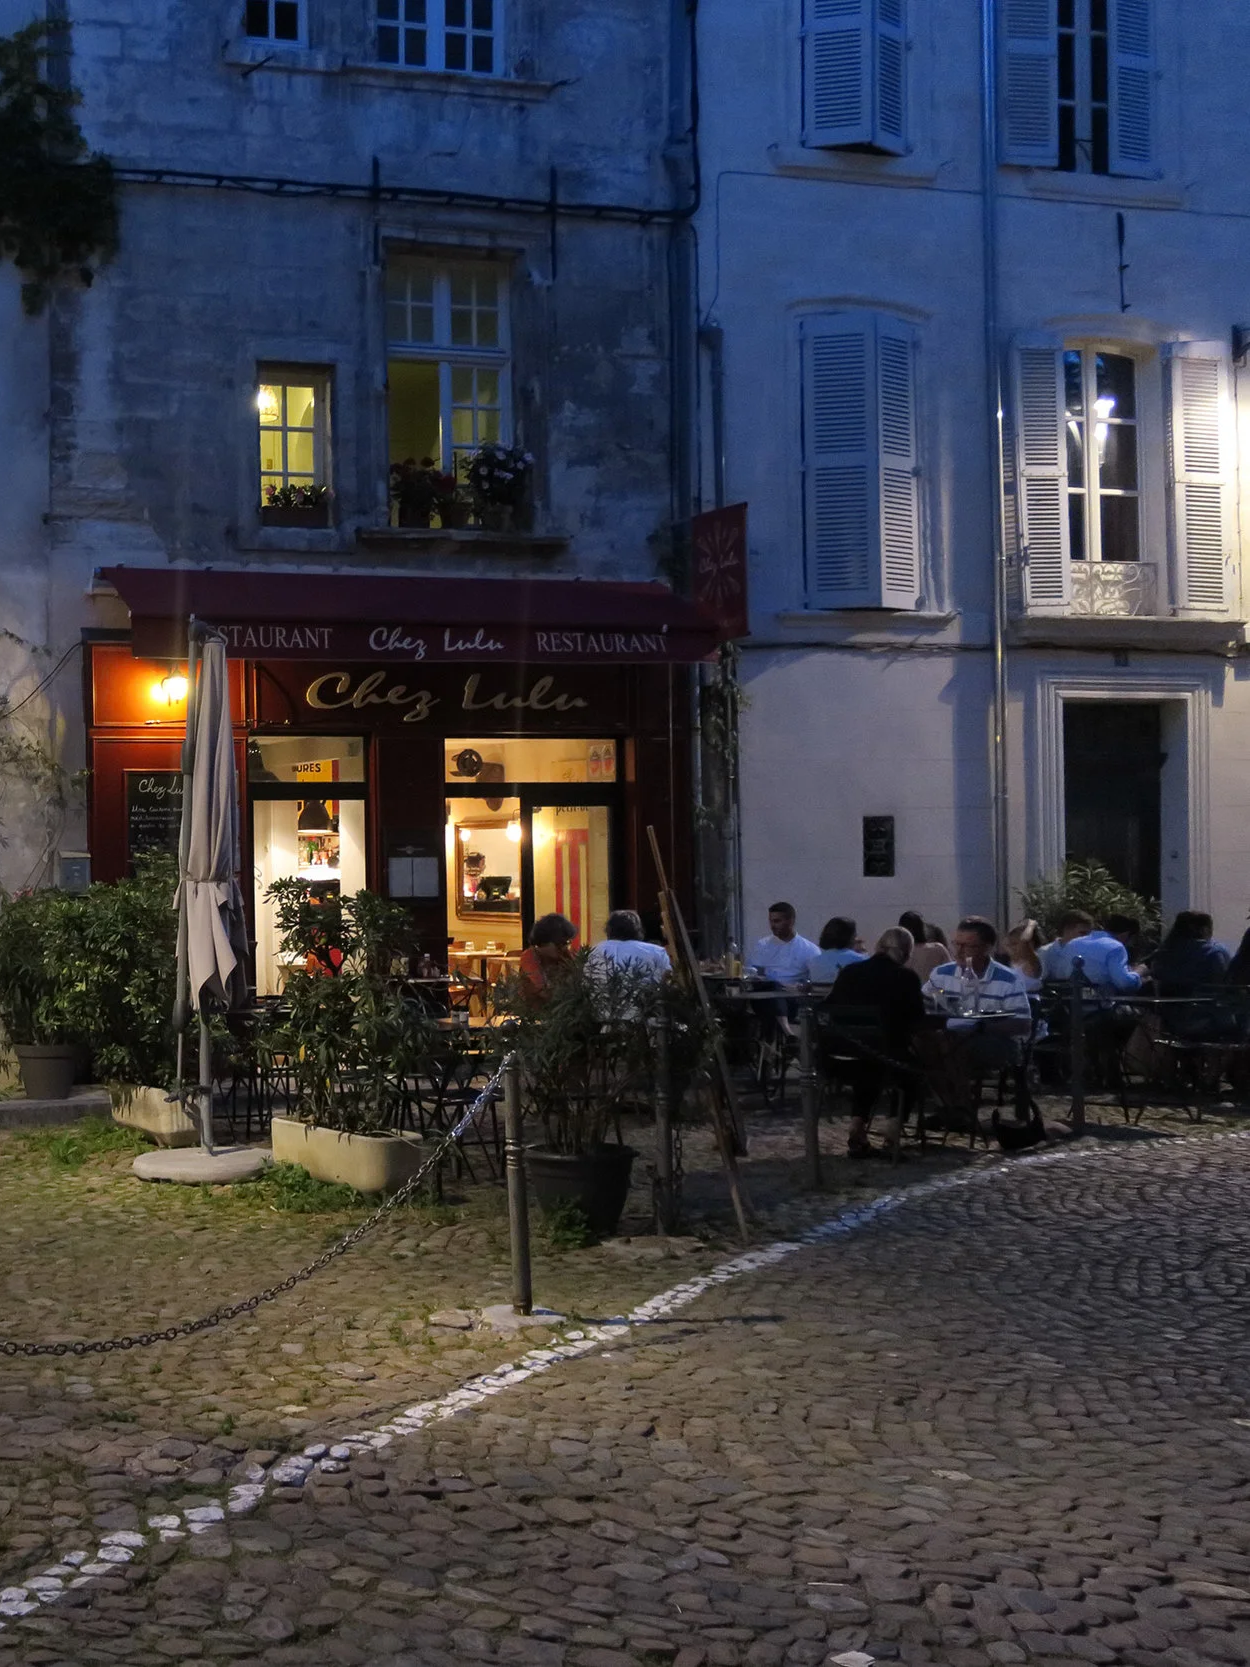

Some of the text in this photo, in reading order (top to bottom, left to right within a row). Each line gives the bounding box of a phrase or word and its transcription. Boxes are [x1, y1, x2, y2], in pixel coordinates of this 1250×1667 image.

[200, 625, 668, 660] STAURANT Chez Lulu RESTAURANT
[306, 670, 589, 722] Chez Lulu
[138, 777, 166, 799] Chez
